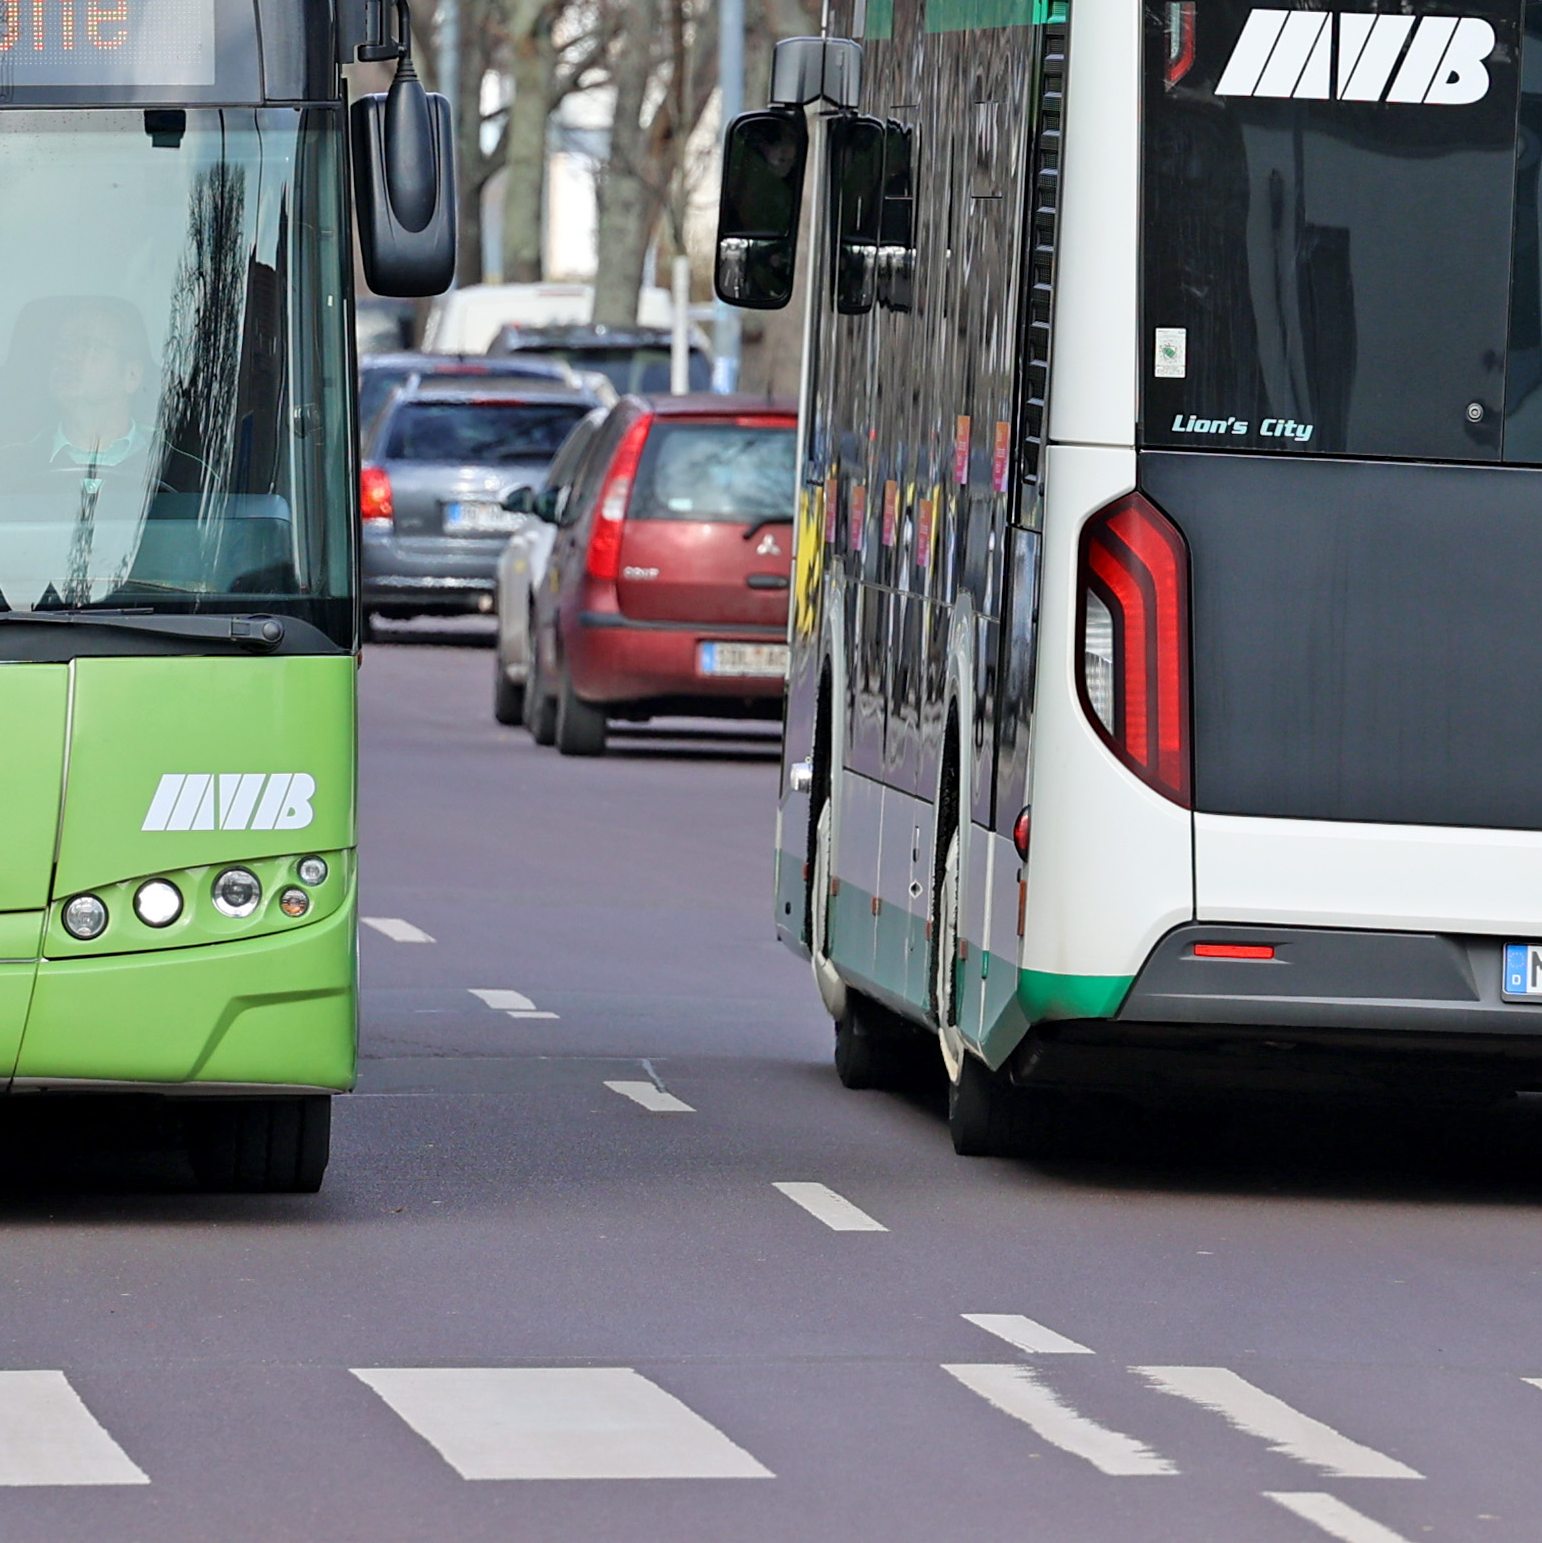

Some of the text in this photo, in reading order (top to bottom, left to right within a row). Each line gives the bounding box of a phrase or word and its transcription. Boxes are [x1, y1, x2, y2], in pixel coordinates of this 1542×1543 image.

[1171, 414, 1313, 442] Lion's City
[1511, 974, 1522, 986] D
